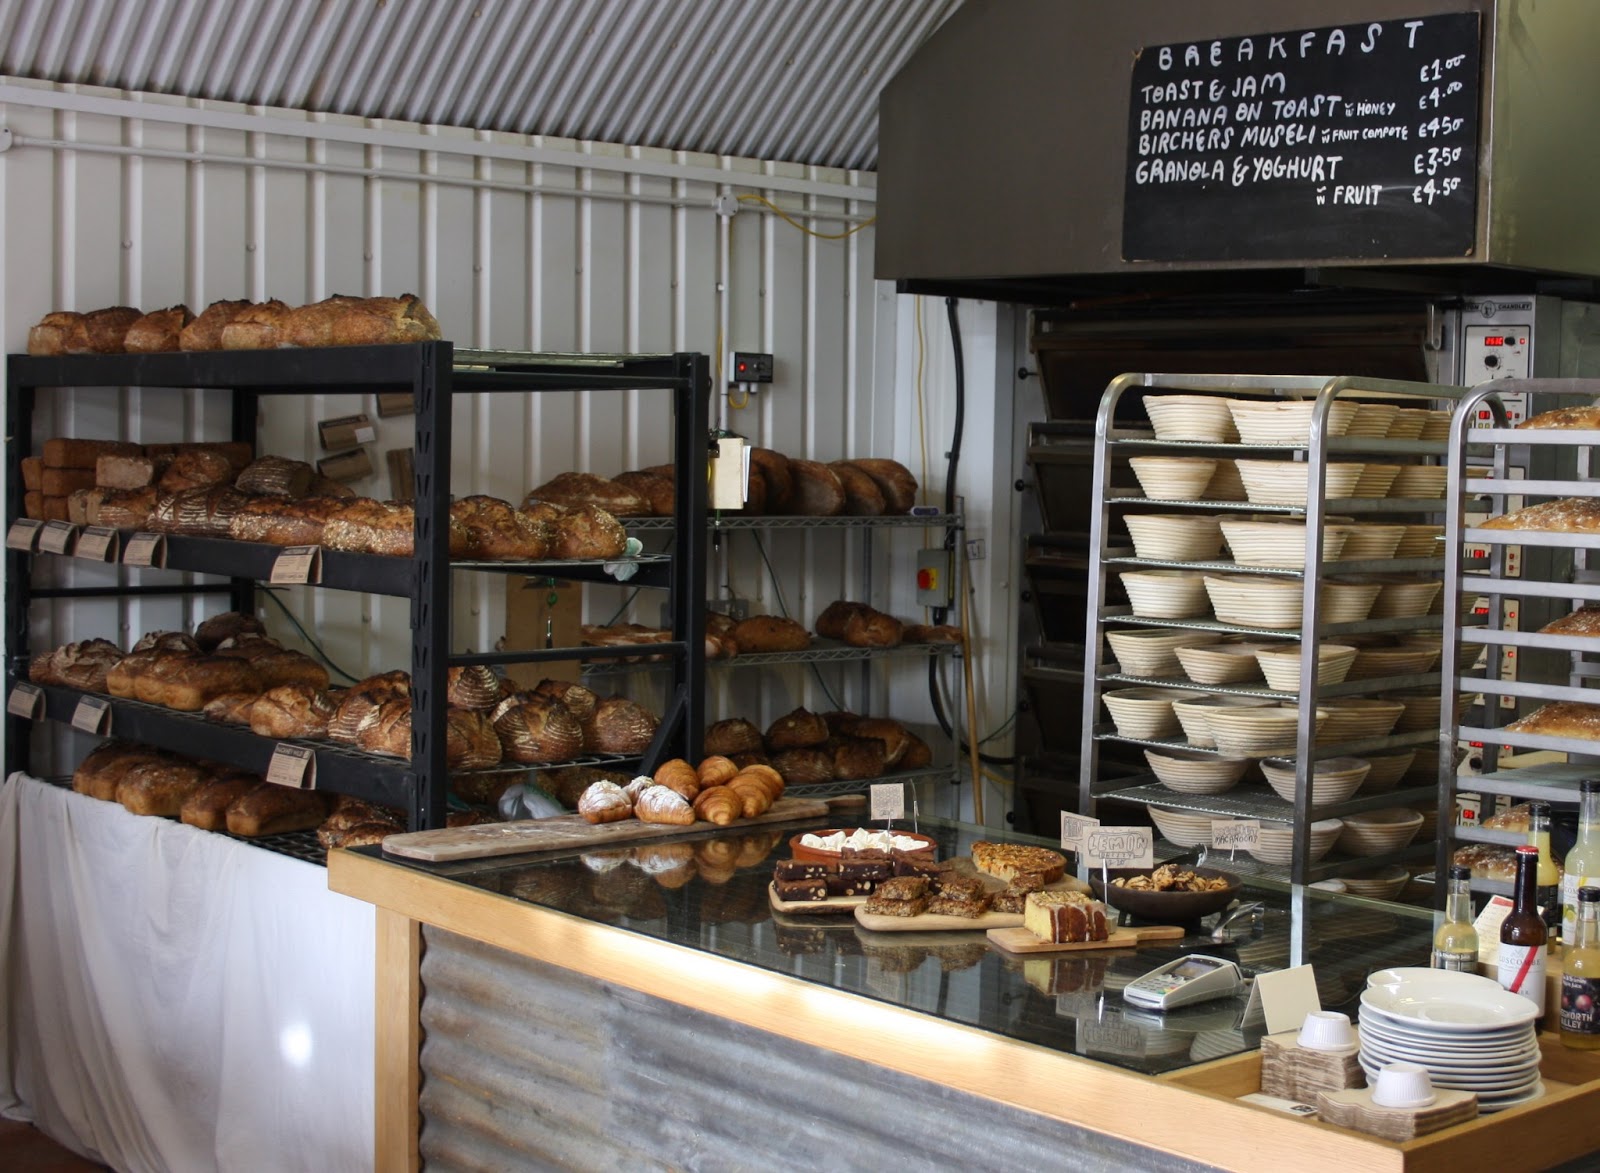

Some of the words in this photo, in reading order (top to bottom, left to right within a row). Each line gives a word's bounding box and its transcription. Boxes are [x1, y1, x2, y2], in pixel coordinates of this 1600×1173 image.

[1158, 20, 1425, 71] BREAKFAST
[1141, 79, 1204, 104] TOAST
[1209, 78, 1227, 102] &
[1232, 71, 1286, 98] JAM
[1140, 105, 1228, 132] BANANA
[1235, 101, 1263, 122] ON
[1272, 94, 1343, 121] TOAST
[1356, 101, 1396, 118] HONEY
[1138, 126, 1235, 156] BIRCHERS
[1240, 123, 1317, 148] MUSELI
[1332, 128, 1360, 142] FRUIT
[1362, 125, 1409, 141] COMPOTE
[1135, 158, 1225, 185] GRANOLA
[1231, 155, 1250, 187] &
[1253, 154, 1344, 183] YOGHURT
[1333, 184, 1383, 206] FRUIT
[1088, 833, 1149, 853] LEMON
